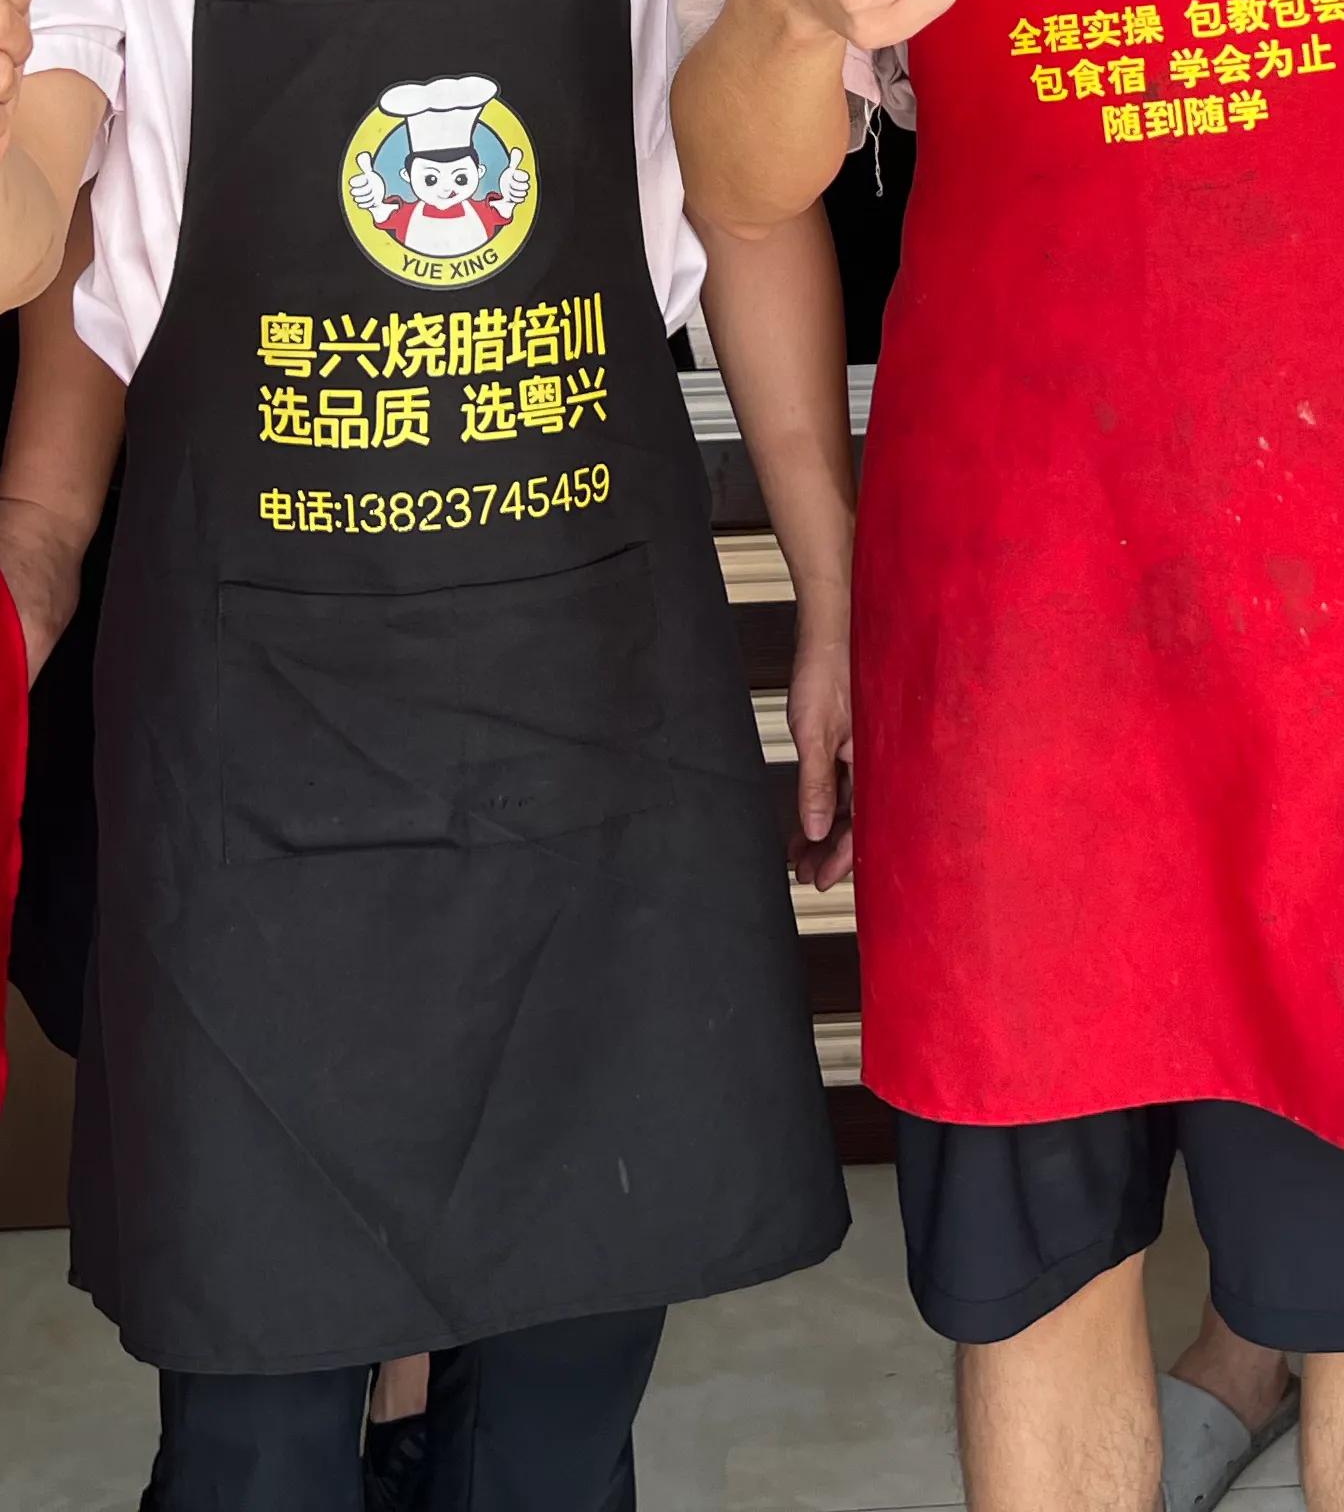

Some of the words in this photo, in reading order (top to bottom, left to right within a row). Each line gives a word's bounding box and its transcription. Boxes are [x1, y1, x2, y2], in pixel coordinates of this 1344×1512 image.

[1008, 4, 1165, 57] 全程实操
[1029, 55, 1147, 103] 包食宿
[1168, 33, 1337, 89] 学会为止
[1101, 89, 1269, 145] 随到随学
[402, 254, 443, 280] YUE
[449, 248, 499, 280] XING
[256, 292, 607, 378] 粤兴烧腊培训
[257, 385, 431, 450] 选品质
[460, 366, 609, 444] 选粤兴
[258, 463, 611, 534] 电话:13823745459
